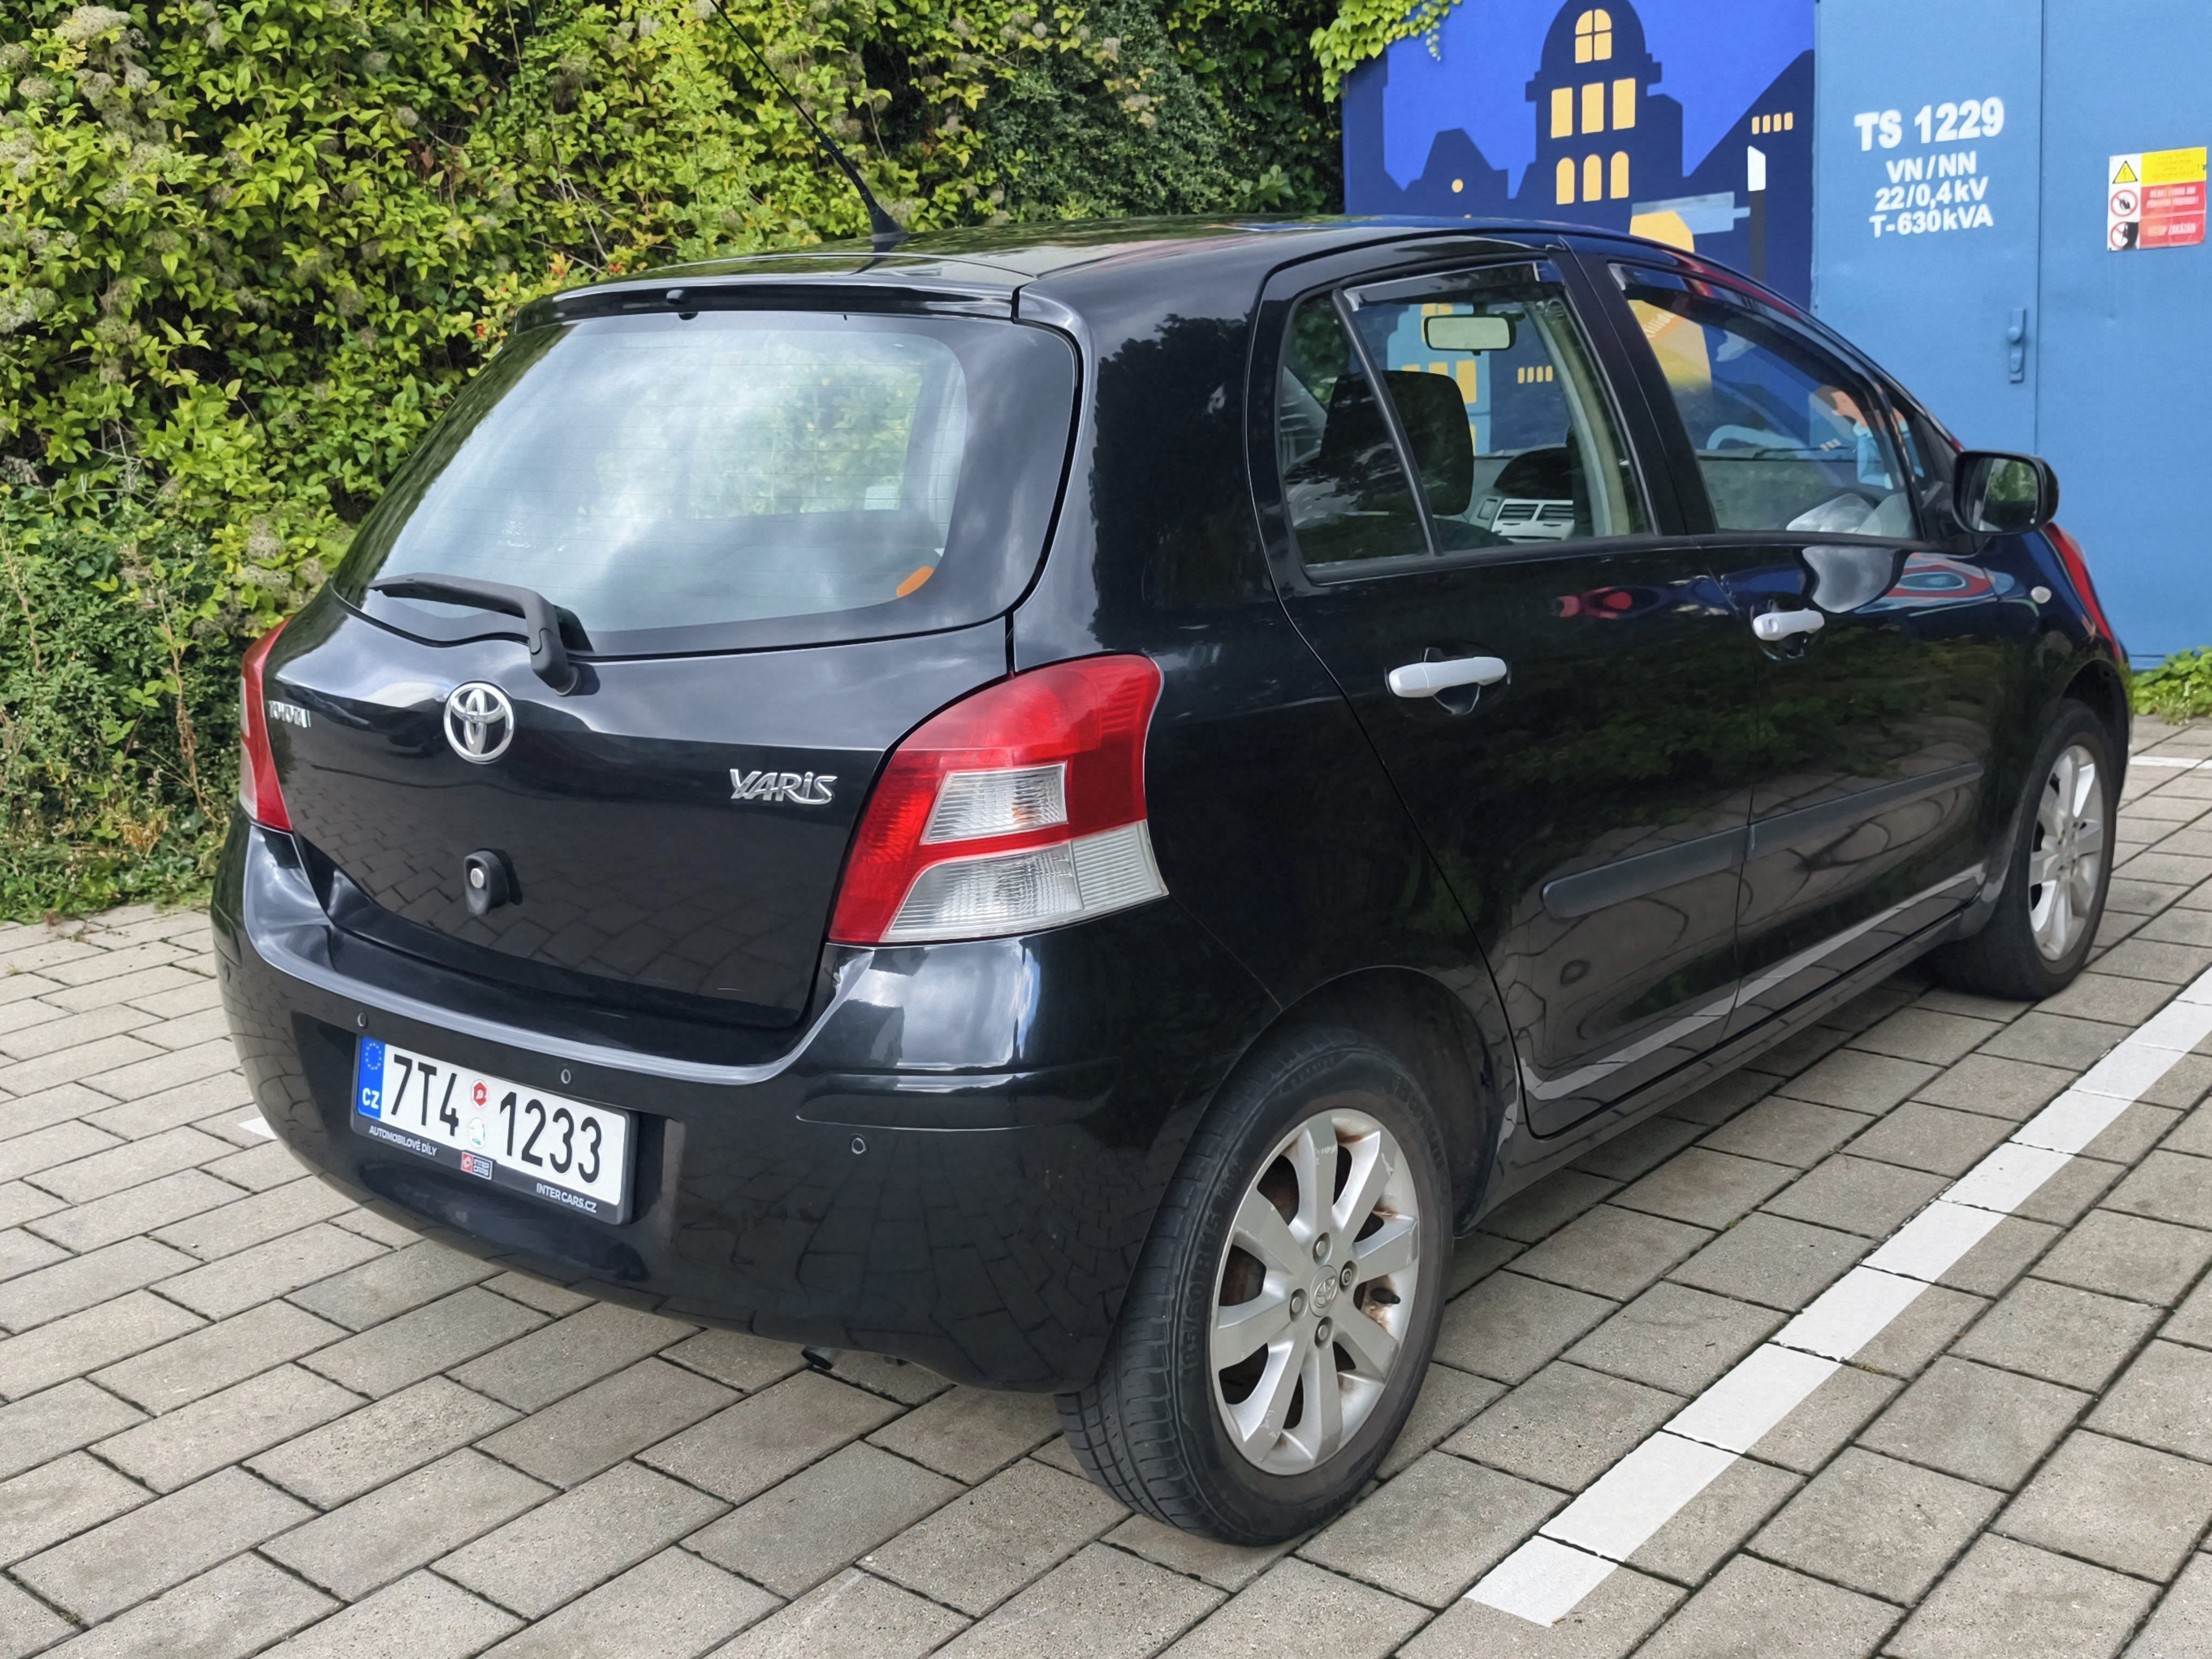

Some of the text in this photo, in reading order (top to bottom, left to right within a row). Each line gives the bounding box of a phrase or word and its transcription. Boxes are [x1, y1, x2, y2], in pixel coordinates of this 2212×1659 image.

[1854, 97, 2004, 151] TS 1229
[1885, 151, 1977, 184] VN/NN
[362, 1087, 380, 1109] CZ
[391, 1054, 602, 1183] 7T4 1233
[369, 1125, 437, 1156] AUTOMOBILOVÉ DÍLY
